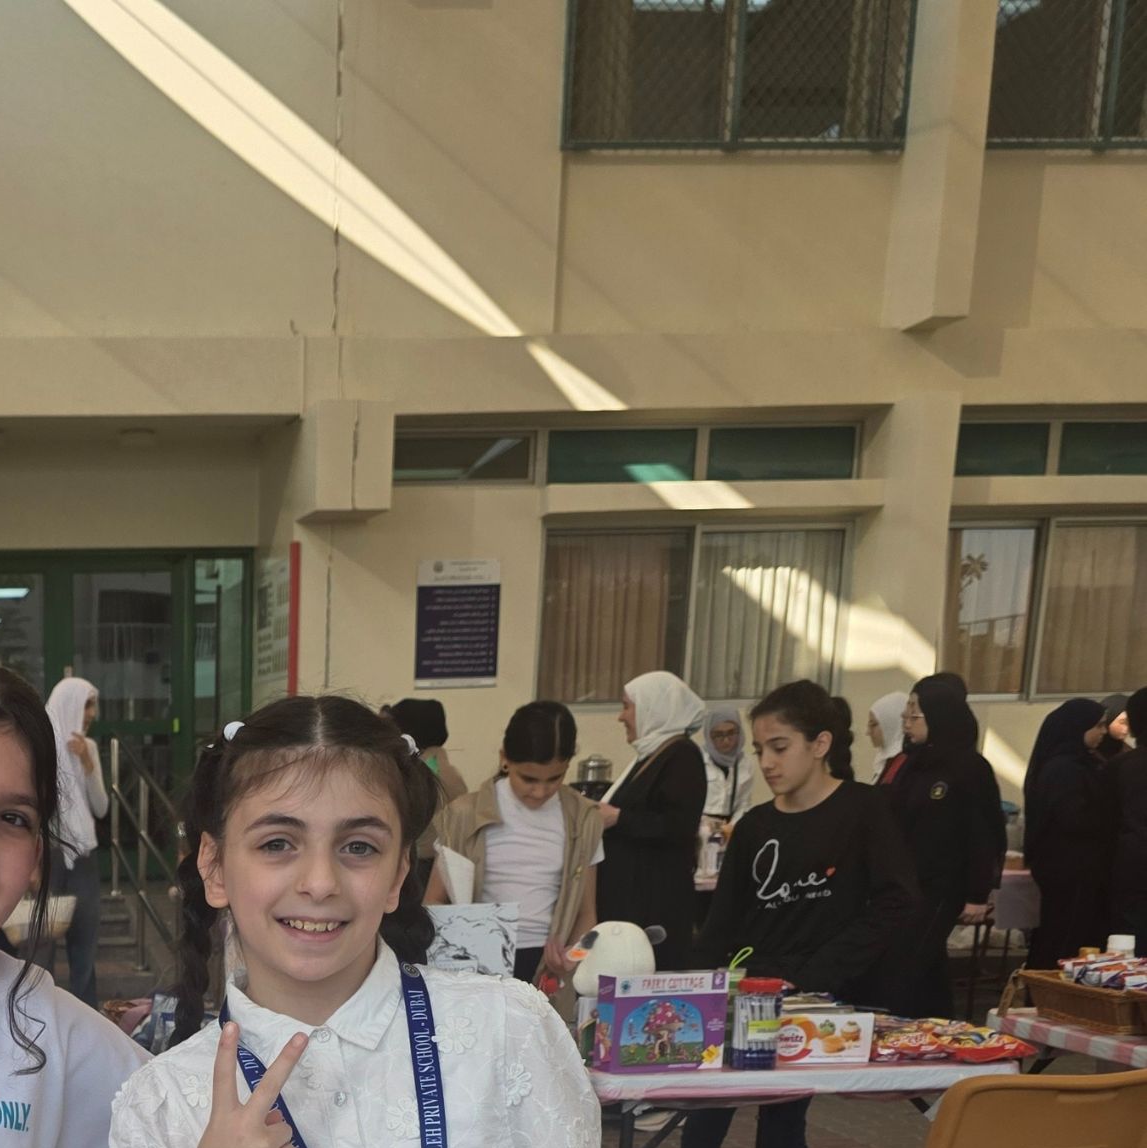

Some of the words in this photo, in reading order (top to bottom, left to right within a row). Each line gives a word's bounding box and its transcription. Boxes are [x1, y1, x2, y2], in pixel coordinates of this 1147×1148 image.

[407, 989, 428, 1021] DUBAI
[414, 1027, 436, 1073] SCHOOL
[420, 1074, 443, 1126] PRIVATE
